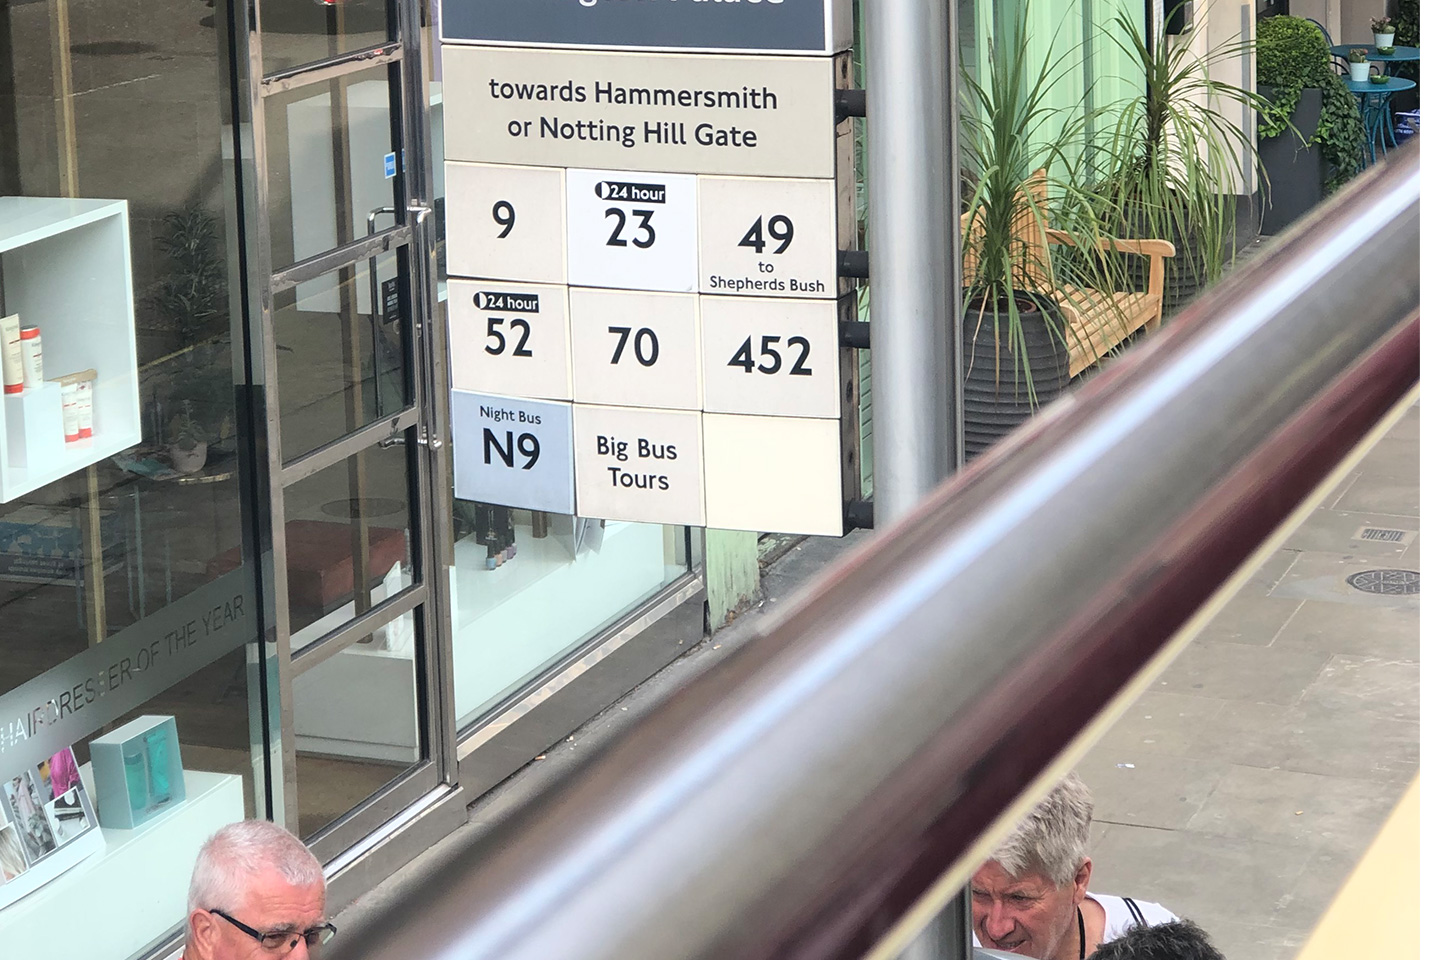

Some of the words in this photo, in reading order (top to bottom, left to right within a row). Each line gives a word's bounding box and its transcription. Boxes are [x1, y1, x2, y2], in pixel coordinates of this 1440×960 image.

[489, 78, 586, 104] towards
[594, 81, 778, 110] Hammersmith
[507, 120, 532, 138] or
[540, 116, 636, 148] Notting
[643, 121, 686, 145] Hill
[694, 123, 757, 148] Gate
[610, 185, 628, 199] 24
[631, 186, 665, 201] hour
[492, 200, 516, 239] 9
[605, 207, 656, 249] 23
[737, 214, 794, 254] 49
[758, 261, 774, 273] to
[709, 275, 785, 293] Shepherds
[790, 278, 825, 293] Bush
[487, 295, 504, 309] 24
[507, 296, 537, 311] hour
[484, 317, 533, 358] 52
[608, 326, 660, 367] 70
[727, 335, 813, 376] 452
[479, 405, 515, 422] Night
[519, 410, 542, 425] Bus
[483, 427, 541, 470] N9
[596, 435, 628, 461] Big
[638, 439, 678, 460] Bus
[607, 467, 670, 491] Tours
[137, 641, 159, 671] OF
[165, 620, 197, 657] THE
[202, 594, 245, 637] YEAR
